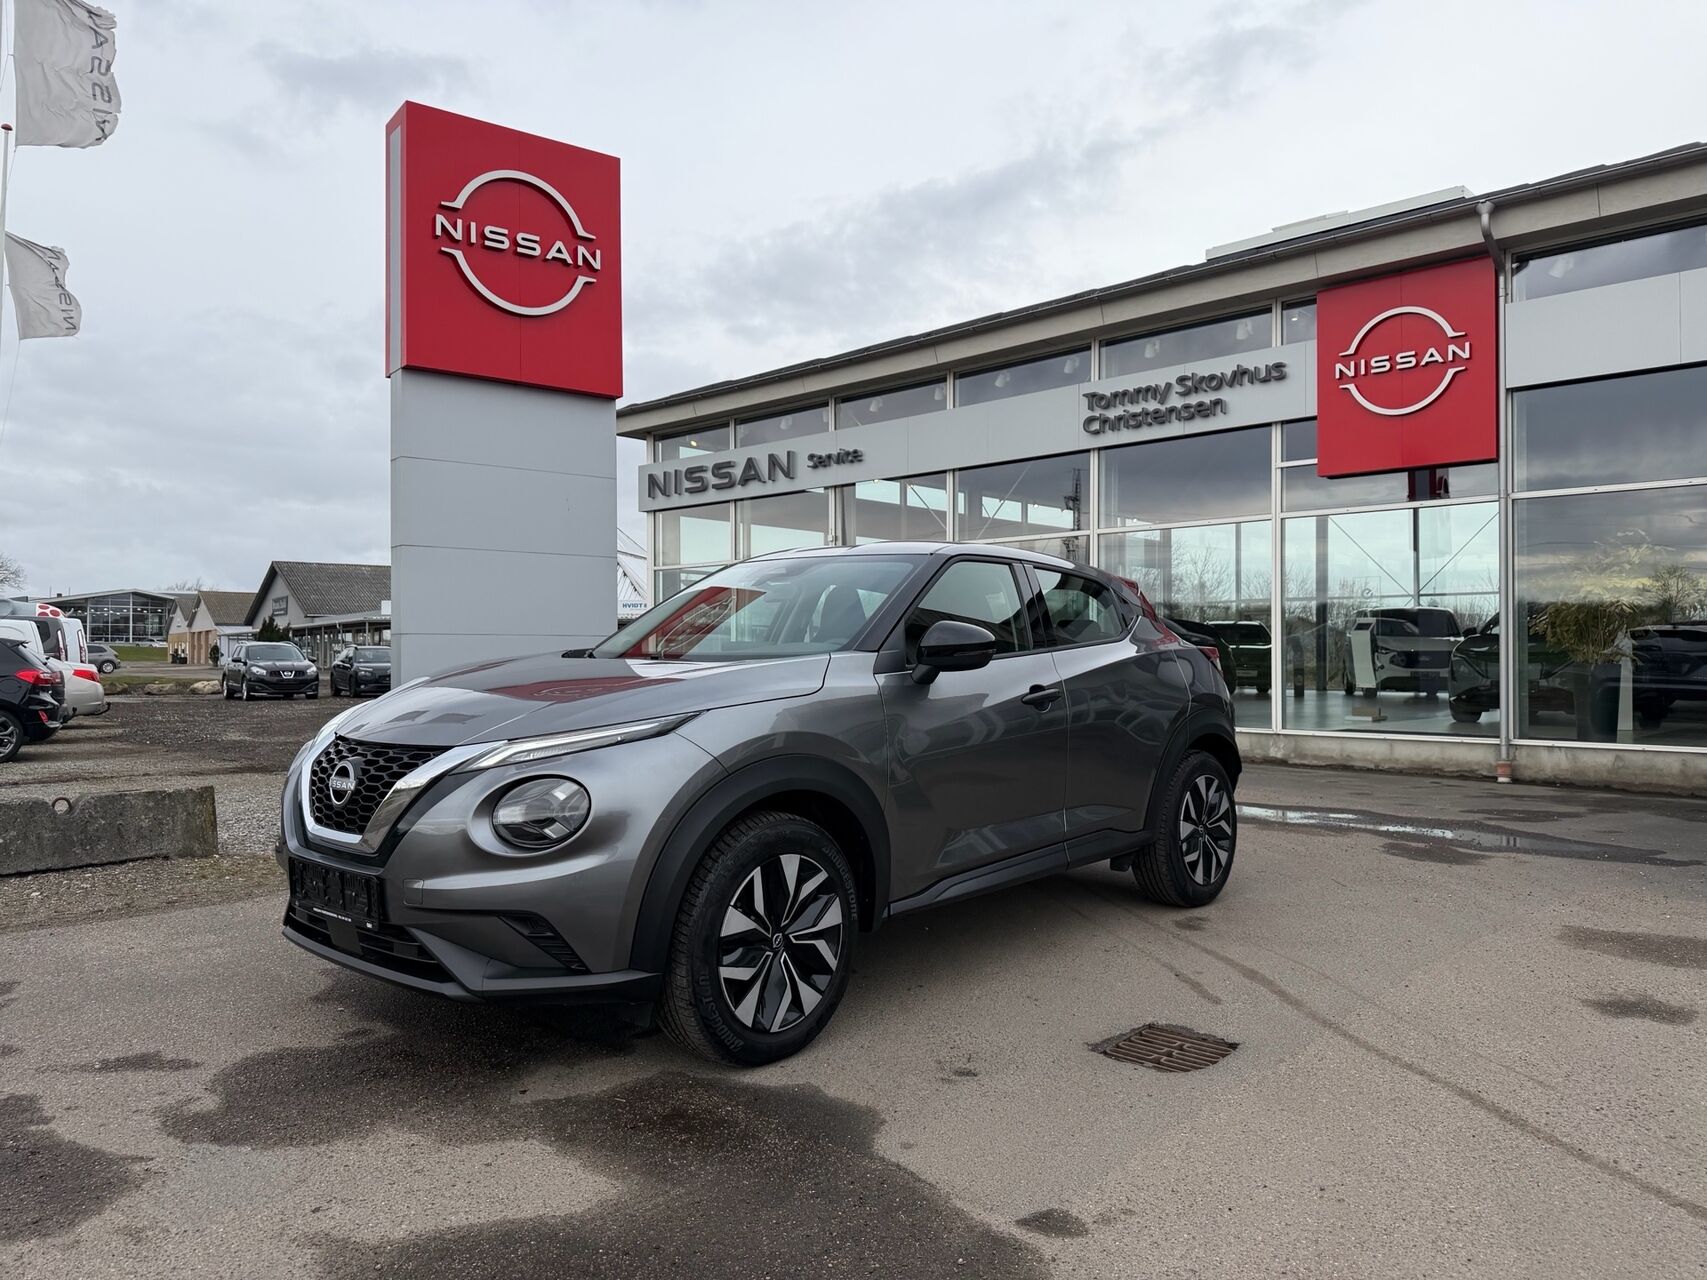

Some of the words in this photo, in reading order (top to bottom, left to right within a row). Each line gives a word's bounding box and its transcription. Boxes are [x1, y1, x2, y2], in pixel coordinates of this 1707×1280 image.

[435, 213, 601, 270] NISSAN
[1334, 341, 1471, 380] NISSAN
[1082, 382, 1172, 412] Tommy
[1175, 361, 1287, 396] Skovhus
[1082, 397, 1227, 434] Christensen
[647, 450, 796, 499] NISSAN
[806, 448, 864, 471] Service
